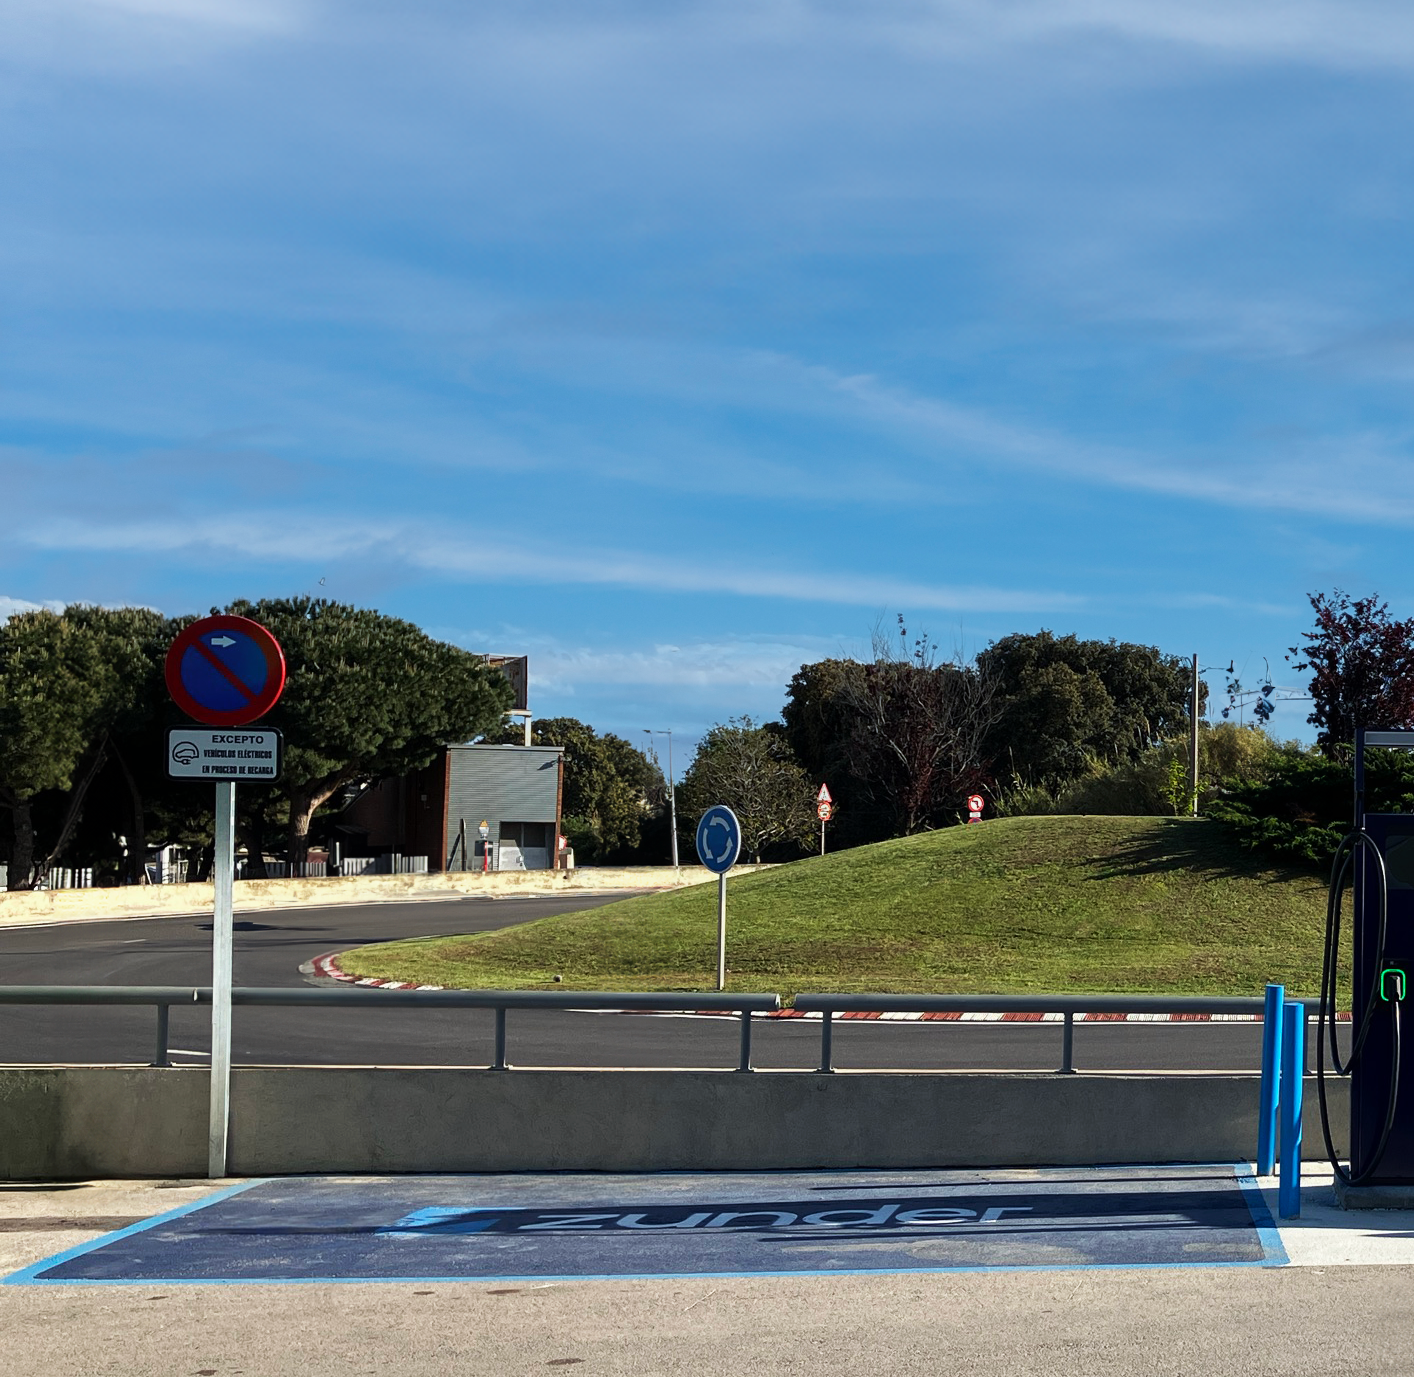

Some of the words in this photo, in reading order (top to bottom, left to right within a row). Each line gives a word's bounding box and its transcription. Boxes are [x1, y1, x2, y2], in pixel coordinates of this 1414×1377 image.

[212, 735, 264, 744] EXCEPTO
[204, 748, 236, 758] VEHÍCULOS
[237, 749, 272, 759] ELÉCTRICOS
[202, 765, 210, 774] EN
[211, 765, 237, 774] PROCESO
[238, 766, 246, 774] DE
[247, 766, 274, 775] RECARGA
[517, 1204, 1034, 1230] zunder
